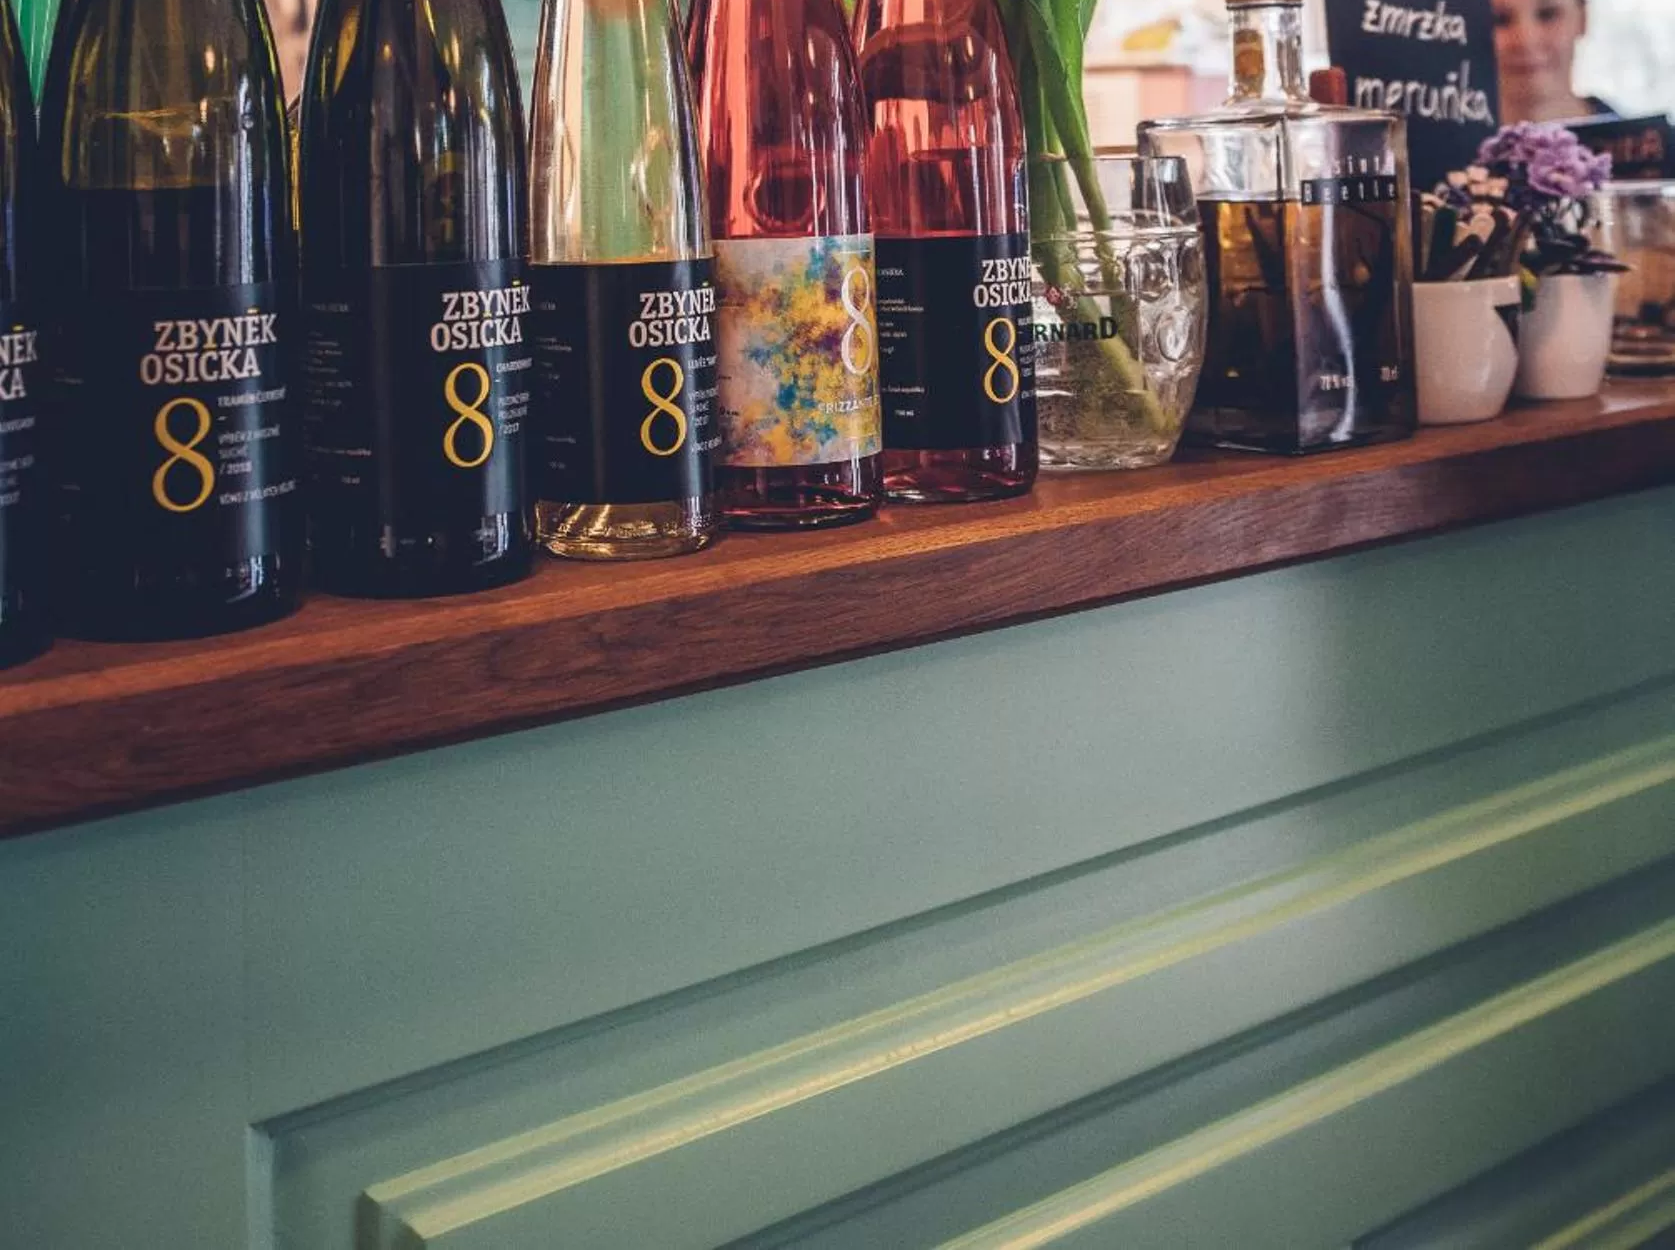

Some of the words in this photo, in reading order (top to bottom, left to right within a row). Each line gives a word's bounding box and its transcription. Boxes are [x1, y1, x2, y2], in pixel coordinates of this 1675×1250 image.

[841, 266, 874, 376] 8
[984, 317, 1020, 403] 8
[1032, 315, 1118, 343] RNARD
[152, 397, 215, 512] 8
[443, 362, 494, 468] 8
[640, 357, 688, 456] 8
